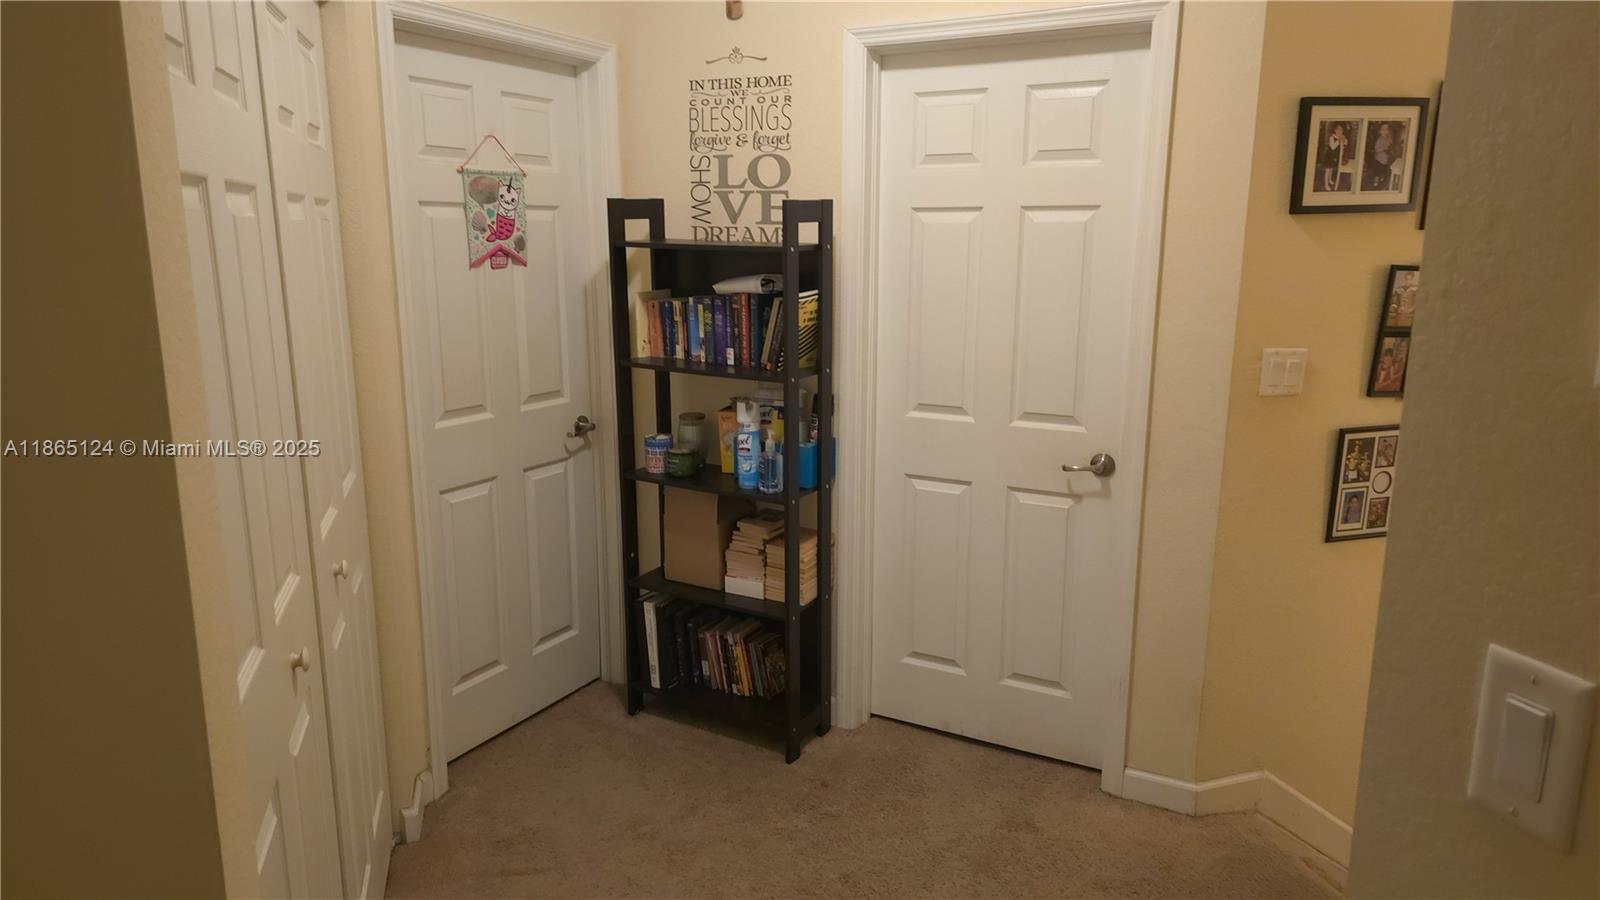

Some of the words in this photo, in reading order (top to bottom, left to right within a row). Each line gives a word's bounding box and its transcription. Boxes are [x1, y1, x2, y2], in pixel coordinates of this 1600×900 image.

[689, 79, 705, 91] IN
[708, 77, 742, 90] THIS
[746, 75, 792, 89] HOME
[689, 97, 746, 107] COUNT
[757, 95, 792, 104] OUR
[730, 89, 749, 97] WE
[689, 104, 792, 132] BLESSINGS
[689, 130, 732, 153] forgive
[736, 134, 749, 147] &
[752, 130, 792, 152] forget
[690, 155, 712, 224] SHOW
